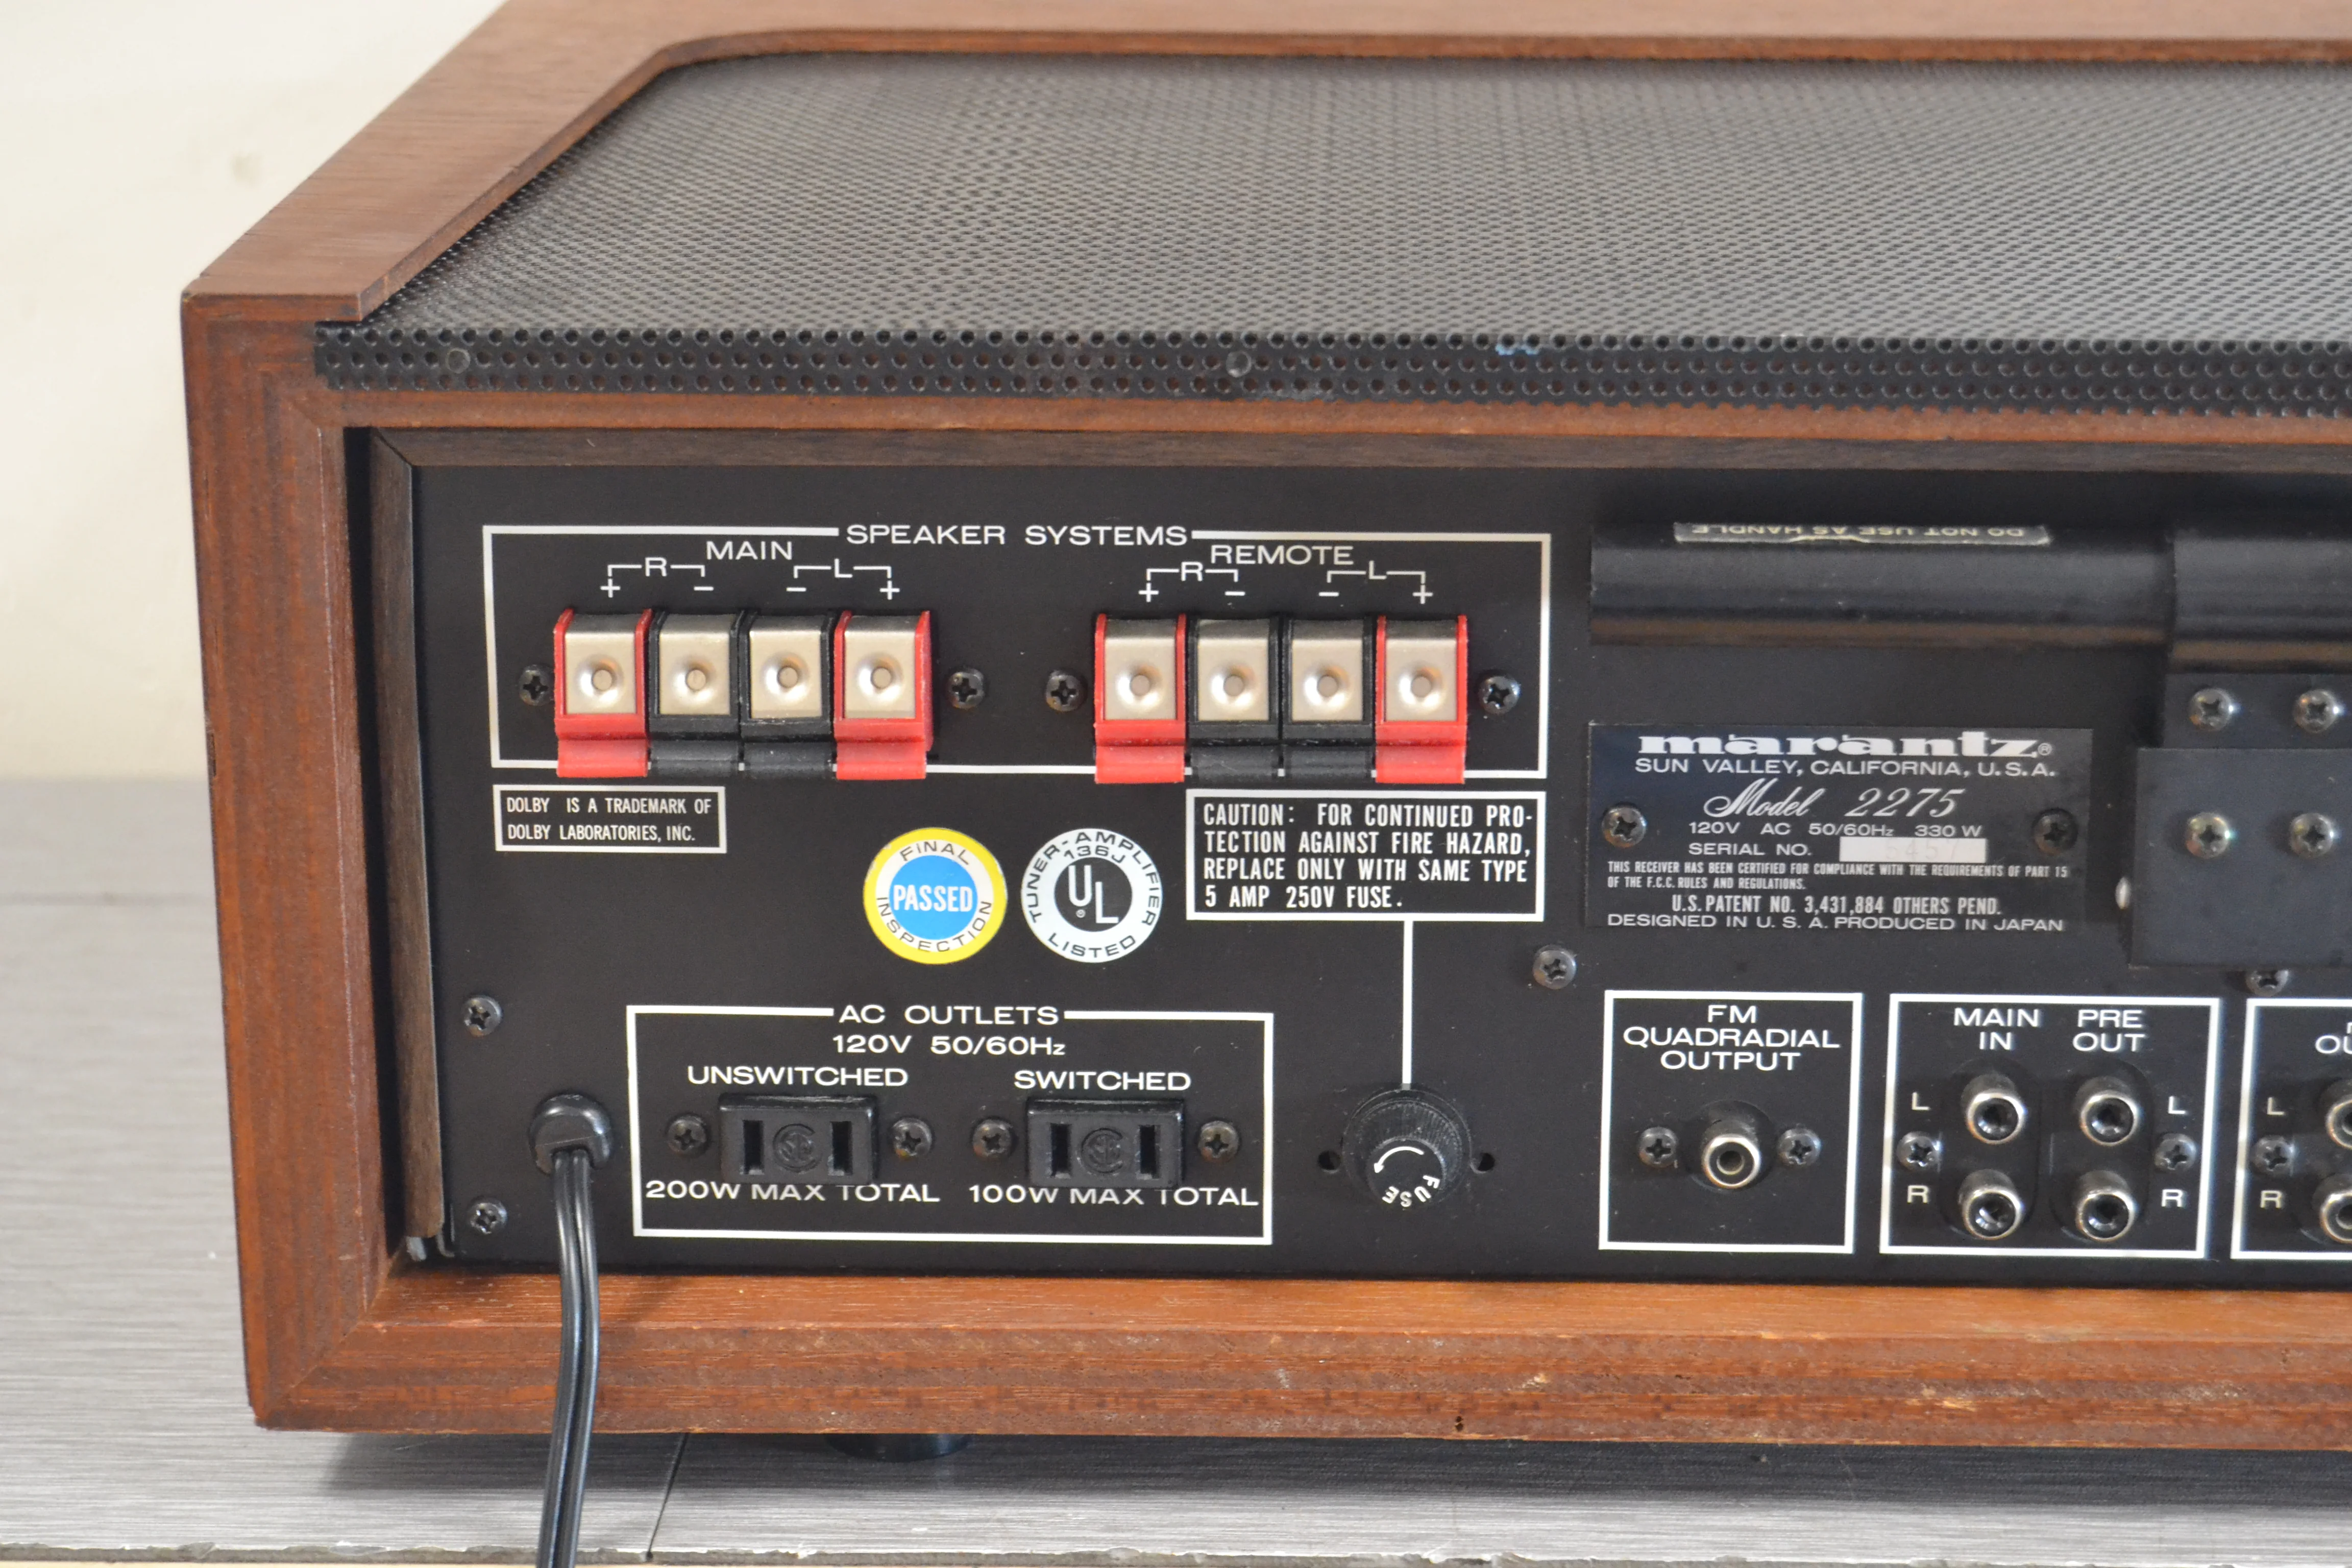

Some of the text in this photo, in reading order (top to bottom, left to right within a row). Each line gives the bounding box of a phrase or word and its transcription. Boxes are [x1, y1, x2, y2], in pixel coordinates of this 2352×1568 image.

[846, 524, 1187, 546] SPEAKER SYSTEMS
[1812, 525, 1848, 536] AS
[1858, 526, 1914, 536] USE
[1924, 527, 1979, 537] NOT
[1987, 527, 2024, 538] DO
[706, 541, 792, 560] MAIN
[1211, 544, 1354, 565] REMOTE
[645, 557, 667, 577] R
[834, 558, 855, 578] L
[1181, 561, 1204, 581] R
[1368, 560, 1386, 580] L
[1635, 757, 1688, 773] SUN
[1702, 759, 1803, 776] VALLEY,
[1810, 760, 1970, 778] CALIFORNIA,
[506, 797, 712, 814] DOLBY IS A TRADEMARK OF
[1703, 777, 1966, 818] Model 2275
[1204, 803, 1532, 828] CAUTION: FOR CONTINUED PRO-
[507, 824, 695, 843] DOLBY LABORATORIES, INC.
[1689, 821, 1741, 834] 120V
[1760, 822, 1791, 836] AC
[1808, 823, 1895, 837] 50/60Hz
[899, 840, 972, 867] FINAL
[1063, 844, 1126, 863] 136J
[1204, 830, 1530, 857] TECTION AGAINST FIRE HAZARD,
[1688, 842, 1766, 855] SERIAL
[1776, 843, 1811, 856] NO.
[1028, 830, 1161, 926] TUNER-AMPLIFIER
[1204, 857, 1527, 883] REPLACE ONLY WITH SAME TYPE
[1607, 861, 2068, 878] THIS RECEIVER HAS BEEN CERTIFIED FOR COMPLIANCE WITH THE REQUIREMENTS OF PART 15
[1607, 876, 1620, 888] OF
[1624, 876, 1642, 888] THE
[1677, 876, 1708, 889] RULES
[1713, 877, 1734, 889] AND
[1738, 877, 1806, 890] REGULATIONS.
[892, 883, 975, 914] PASSED
[1205, 885, 1402, 909] 5 AMP 250V FUSE.
[1672, 894, 2001, 916] U.S. PATENT NO. 3,431,884 OTHERS PEND.
[876, 896, 993, 953] INSPECTION
[1607, 914, 1717, 927] DESIGNED
[1726, 915, 1747, 927] IN
[1834, 916, 1955, 930] PRODUCED
[1965, 918, 1987, 930] IN
[1993, 918, 2063, 931] JAPAN
[1047, 934, 1137, 958] LISTED
[839, 1004, 1059, 1025] AC OUTLETS
[1707, 1004, 1757, 1023] FM
[1953, 1007, 2040, 1027] MAIN
[2077, 1009, 2143, 1028] PRE
[832, 1034, 1066, 1056] 120V 50/60Hz
[1623, 1026, 1841, 1048] QUADRADIAL
[1979, 1032, 2013, 1050] IN
[2072, 1032, 2146, 1052] OUT
[1660, 1050, 1801, 1071] OUTPUT
[688, 1065, 909, 1087] UNSWITCHED
[1014, 1070, 1191, 1091] SWITCHED
[1912, 1092, 1929, 1111] L
[2168, 1096, 2186, 1115] L
[2267, 1097, 2285, 1116] L
[646, 1180, 941, 1203] 200W MAX TOTAL
[969, 1184, 1260, 1207] 100W MAX TOTAL
[1382, 1174, 1440, 1208] FUSE
[1907, 1185, 1929, 1203] R
[2161, 1189, 2184, 1208] R
[2260, 1190, 2283, 1208] R
